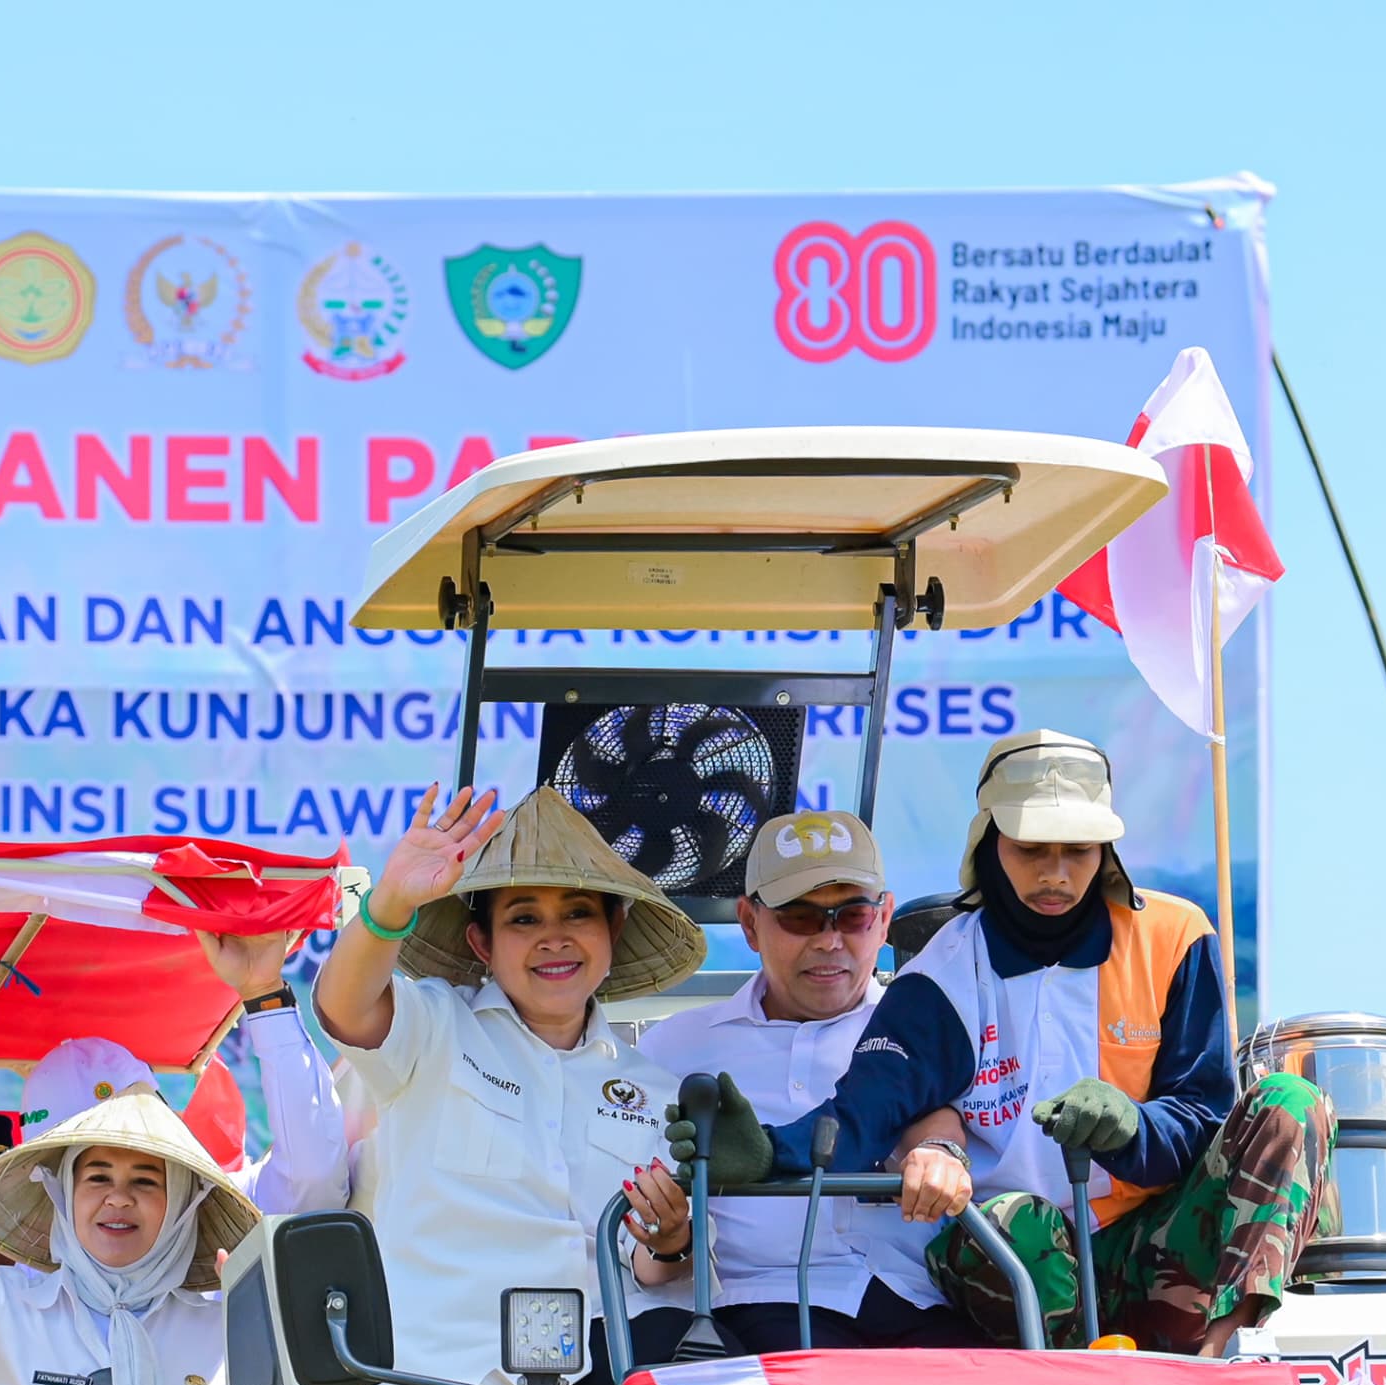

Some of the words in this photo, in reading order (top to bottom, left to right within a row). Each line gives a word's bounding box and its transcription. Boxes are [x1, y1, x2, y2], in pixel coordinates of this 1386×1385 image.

[951, 241, 1065, 269] Bersatu
[1074, 238, 1213, 268] Berdaulat
[774, 221, 937, 363] 80
[951, 279, 1051, 311] Rakyat
[1060, 276, 1199, 310] Sejahtera
[951, 316, 1093, 342] Indonesia
[1101, 314, 1167, 344] Maju
[86, 596, 224, 645] DAN
[153, 786, 499, 836] SULAW
[597, 1106, 618, 1120] K-4
[621, 1111, 660, 1130] DPR-RI
[962, 1099, 998, 1112] PUPUK
